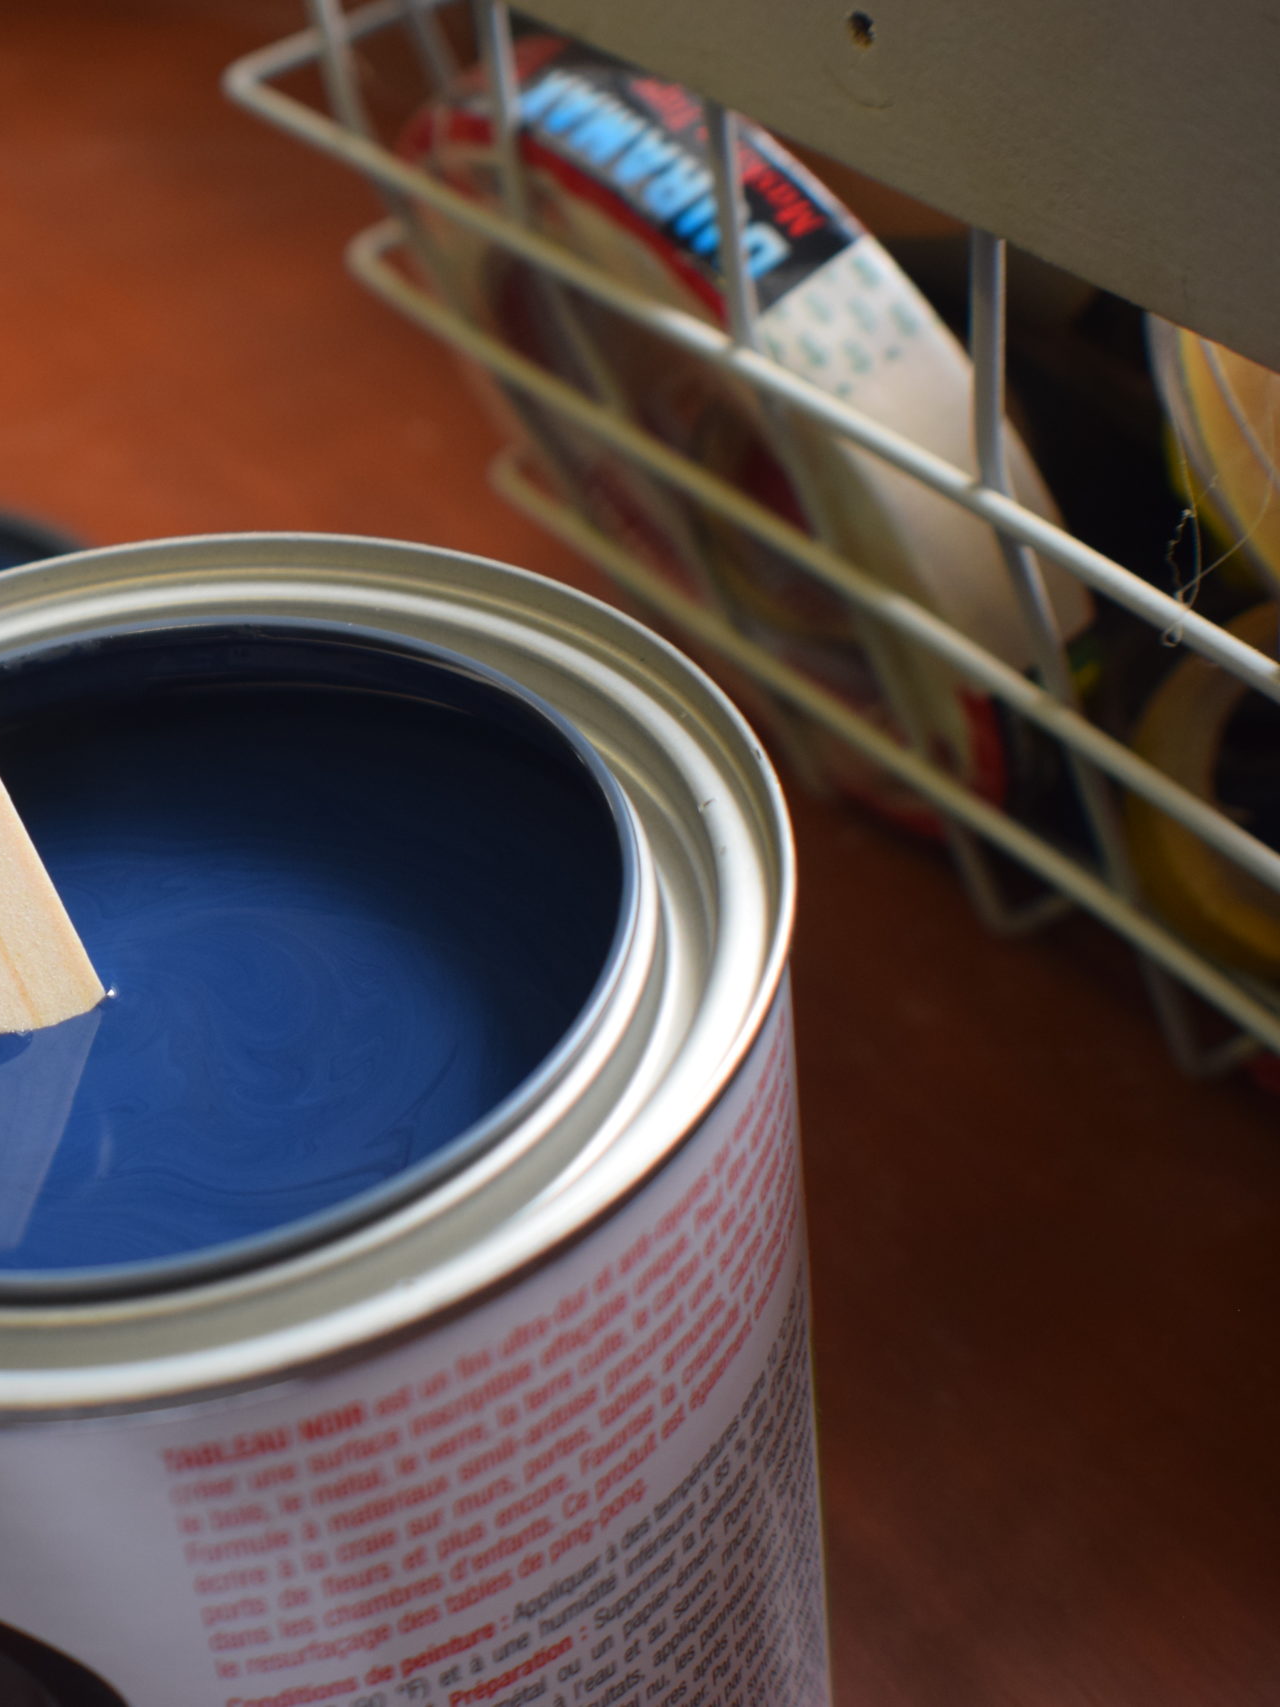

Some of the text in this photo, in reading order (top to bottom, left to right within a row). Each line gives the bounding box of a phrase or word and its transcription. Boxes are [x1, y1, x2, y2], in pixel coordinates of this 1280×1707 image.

[252, 1465, 295, 1489] une
[311, 1431, 398, 1472] surface
[401, 1547, 425, 1571] et
[437, 1523, 484, 1560] plus
[407, 1511, 440, 1538] sur
[364, 1665, 395, 1686] de
[400, 1623, 495, 1677] peinture
[513, 1557, 599, 1621] Appliquer
[621, 1516, 651, 1550] des
[397, 1606, 440, 1634] des
[445, 1570, 513, 1613] tables
[517, 1551, 544, 1578] de
[450, 1637, 572, 1707] Préparation
[594, 1550, 675, 1628] Supprimer
[492, 1632, 529, 1662] une
[623, 1639, 640, 1663] et
[647, 1618, 667, 1644] au
[557, 1658, 581, 1683] ou
[590, 1635, 614, 1661] un
